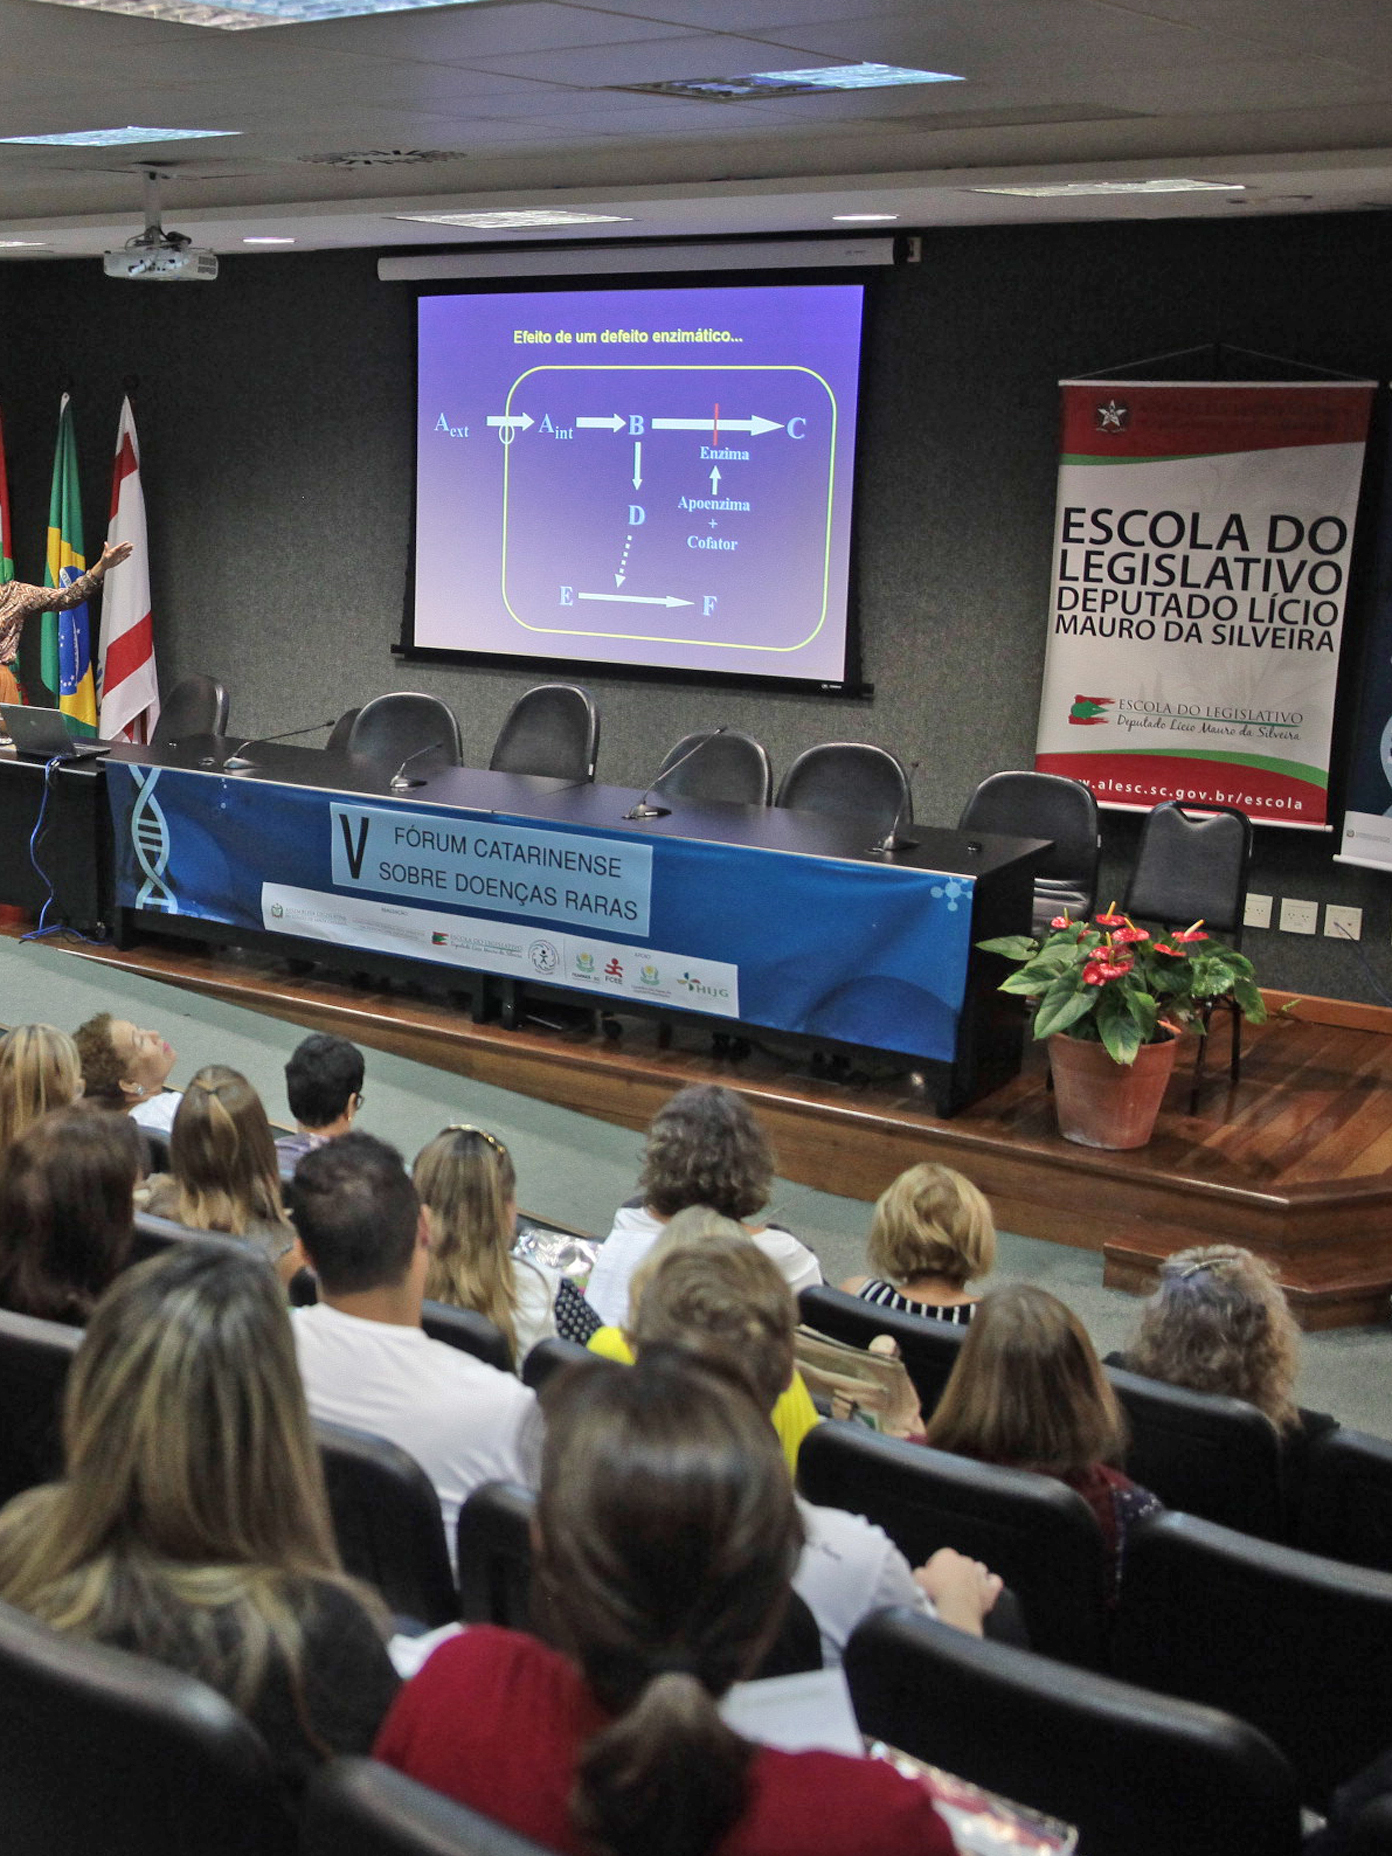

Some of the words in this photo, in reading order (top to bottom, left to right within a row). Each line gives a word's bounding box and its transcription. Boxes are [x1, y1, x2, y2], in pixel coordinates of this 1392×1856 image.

[513, 330, 552, 344] Efeito
[555, 330, 572, 344] de
[576, 333, 597, 343] um
[600, 329, 649, 343] defeito
[652, 328, 743, 343] enzimático...
[628, 415, 645, 435] B
[786, 417, 806, 439] C
[699, 446, 749, 460] Enzima
[628, 505, 645, 525] D
[678, 496, 750, 512] Apoenzima
[686, 535, 738, 551] Cofator
[1061, 507, 1250, 552] ESCOLA
[1267, 515, 1348, 556] DO
[1059, 549, 1343, 595] LEGISLATIVO
[559, 586, 573, 606] E
[703, 595, 718, 616] F
[1057, 586, 1238, 621] DEPUTADO
[1248, 592, 1338, 627] LÍCIO
[1055, 614, 1156, 640] MAURO
[1163, 621, 1203, 644] DA
[1211, 624, 1335, 652] SILVEIRA
[1118, 699, 1172, 714] ESCOLA
[1177, 704, 1201, 716] DO
[1206, 707, 1304, 724] LEGISLATIVO
[1117, 714, 1166, 732] Deputado
[1198, 722, 1236, 736] Mauro
[1239, 725, 1253, 737] da
[1258, 726, 1301, 741] Silveira
[1079, 779, 1303, 810] w.alesc.sc.gov.br/escola
[339, 813, 370, 880] V
[394, 824, 467, 855] FÓRUM
[474, 838, 622, 878] CATARINENSE
[379, 862, 447, 889] SOBRE
[455, 873, 557, 907] DOENÇAS
[565, 890, 638, 921] RARAS
